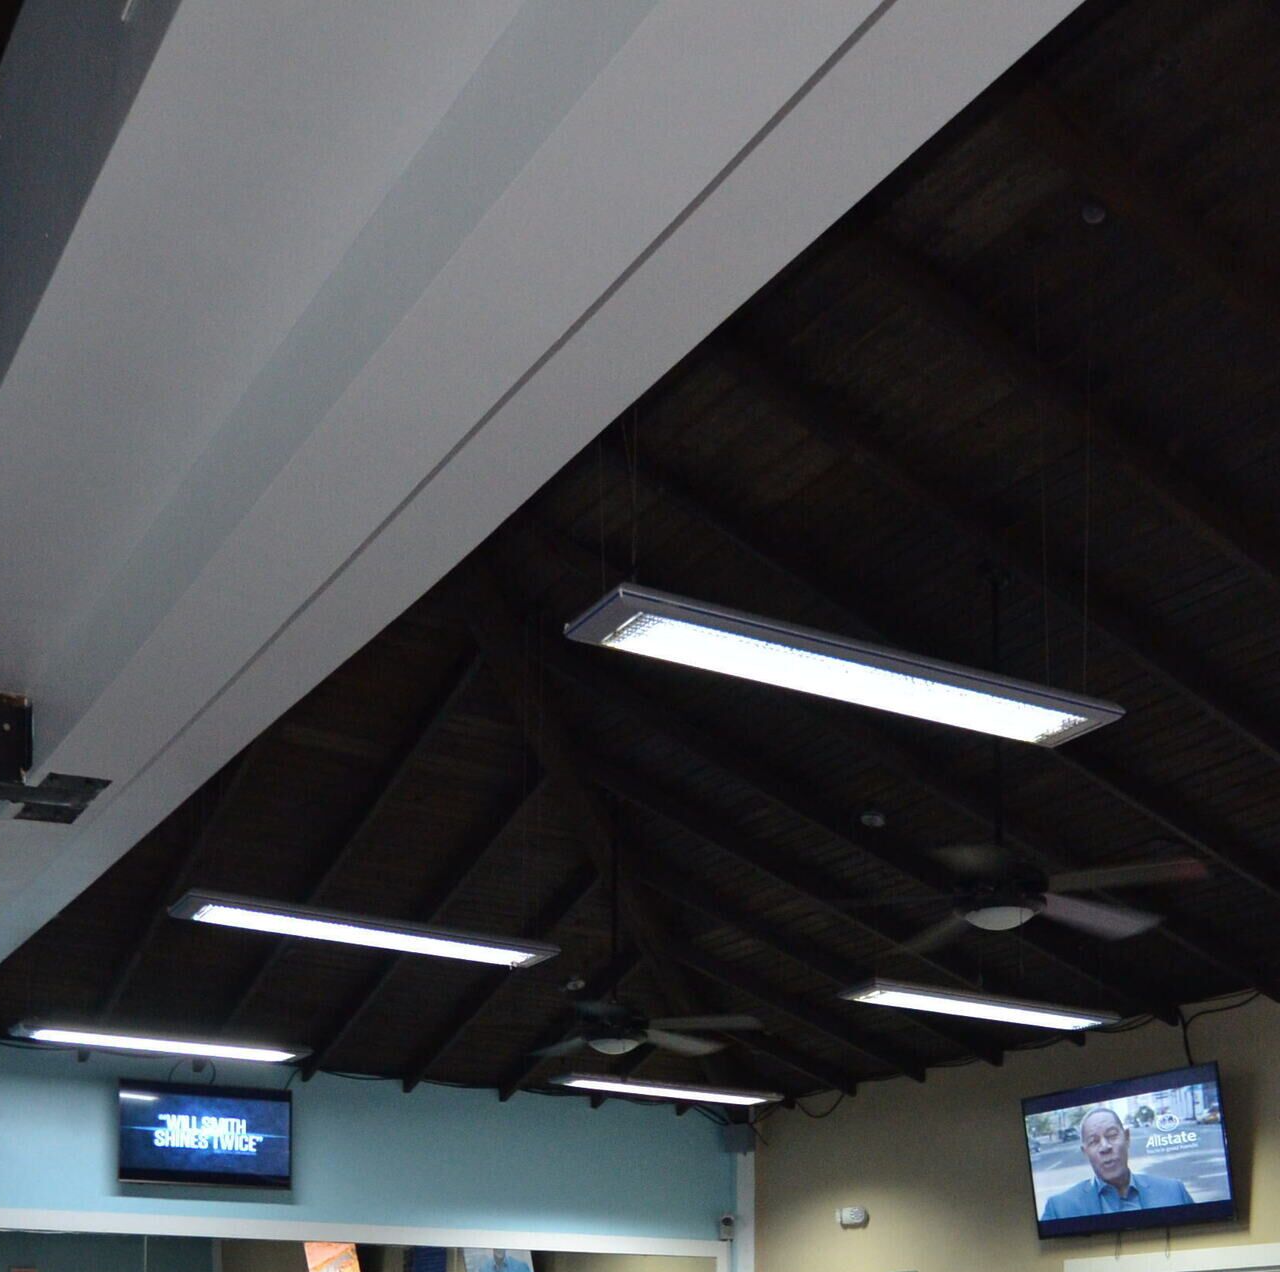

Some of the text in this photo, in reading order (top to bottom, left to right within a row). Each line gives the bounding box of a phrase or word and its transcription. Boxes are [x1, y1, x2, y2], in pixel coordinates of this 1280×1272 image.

[201, 1116, 247, 1135] SMITH
[153, 1130, 209, 1149] SHINES
[1145, 1130, 1198, 1148] Allstate
